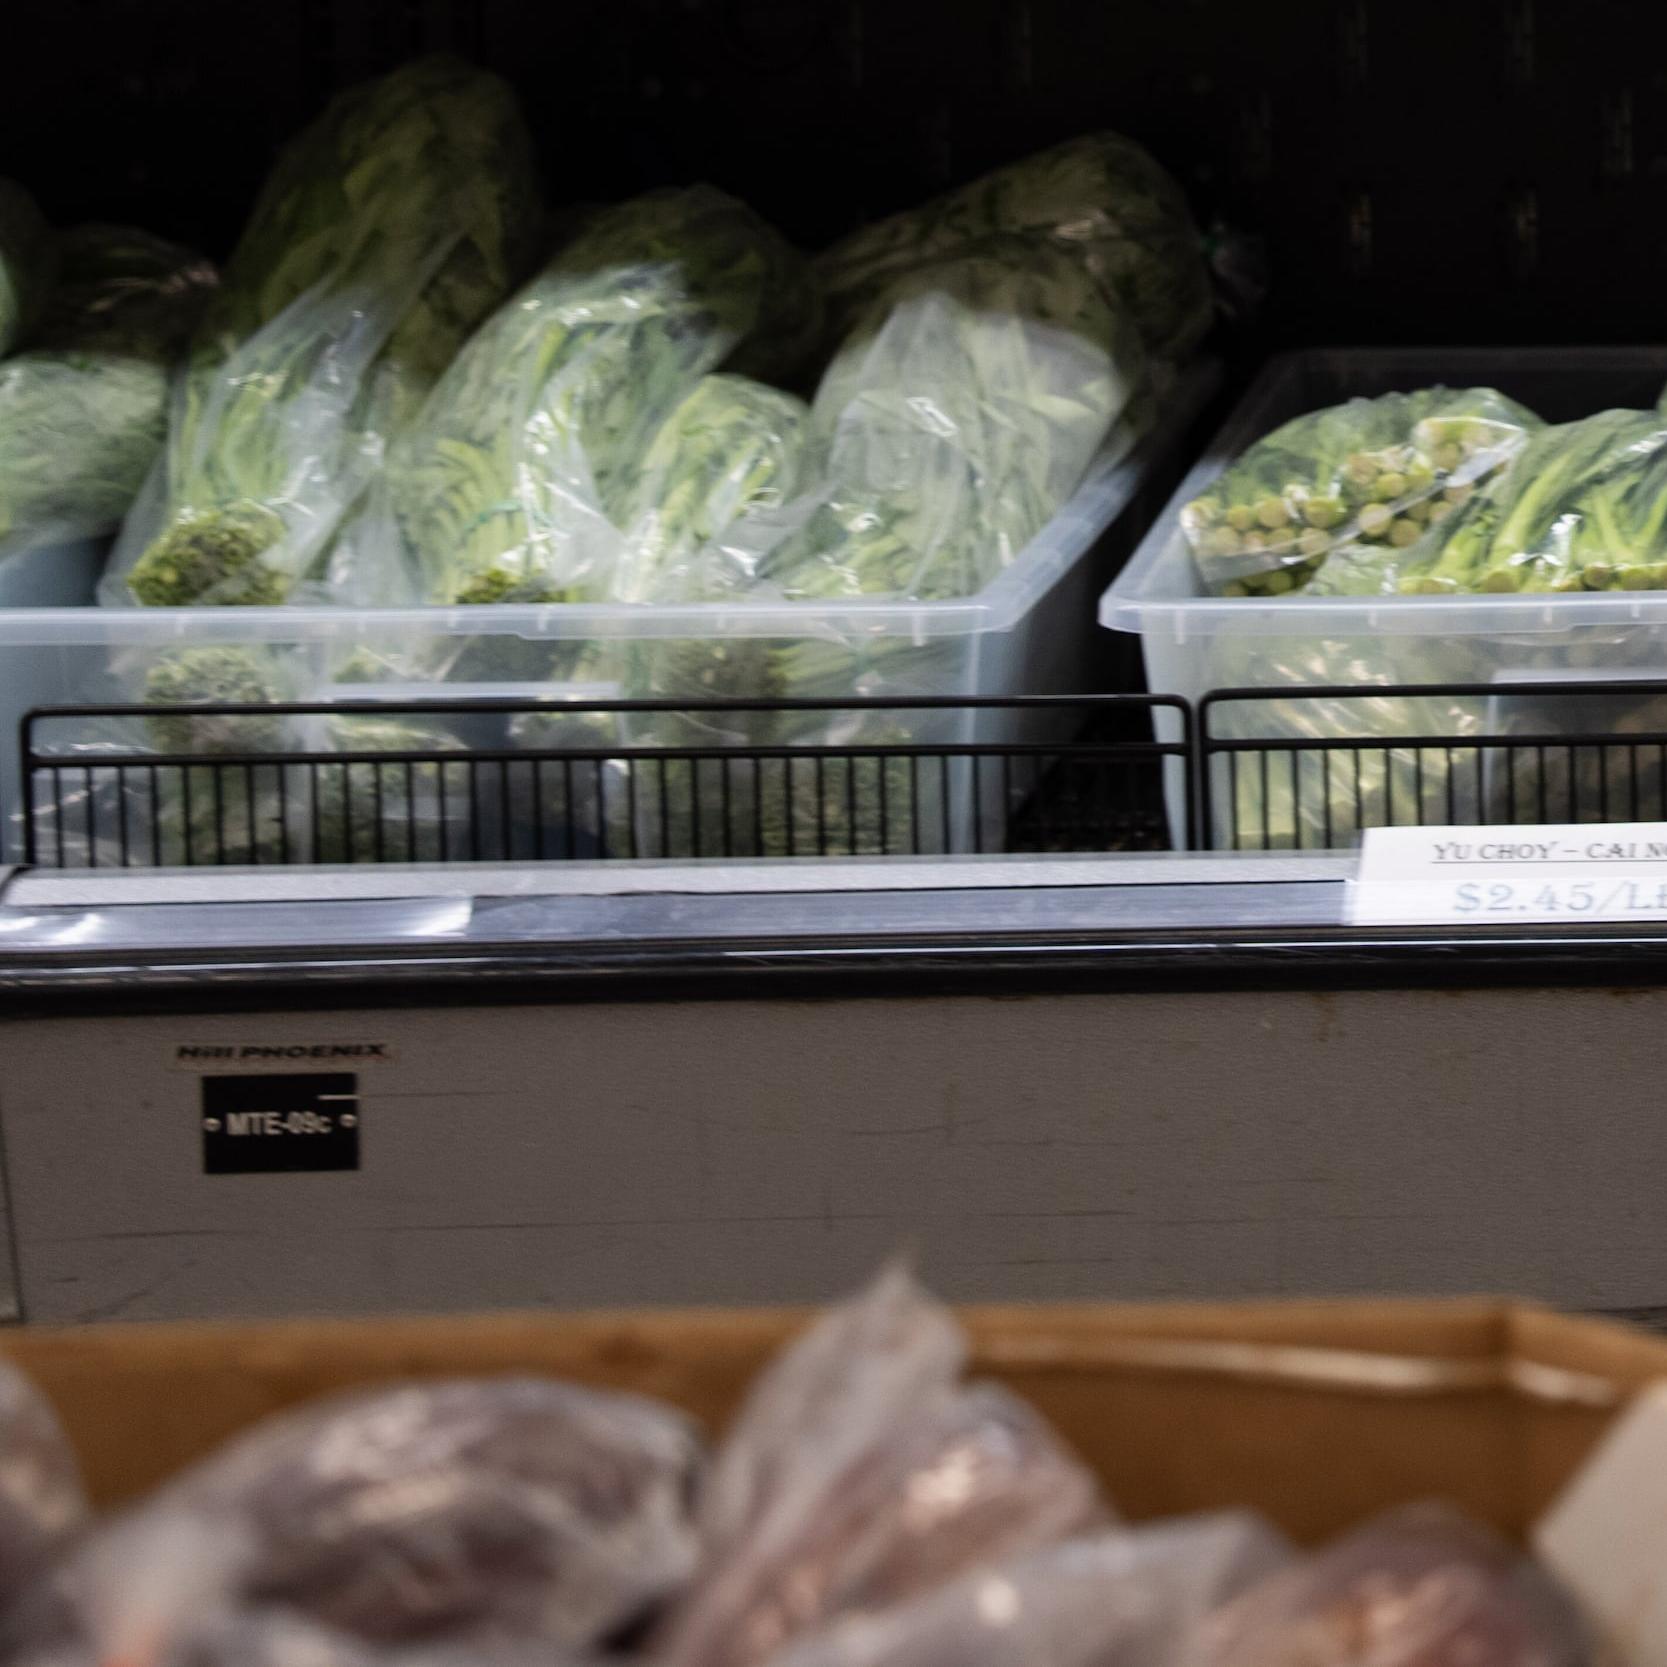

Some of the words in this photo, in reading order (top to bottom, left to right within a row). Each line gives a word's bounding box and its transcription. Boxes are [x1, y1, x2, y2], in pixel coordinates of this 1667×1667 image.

[1432, 840, 1472, 860] YU
[1479, 840, 1558, 860] CHOY
[1585, 841, 1636, 860] CAI
[239, 1043, 387, 1058] PHOENIX
